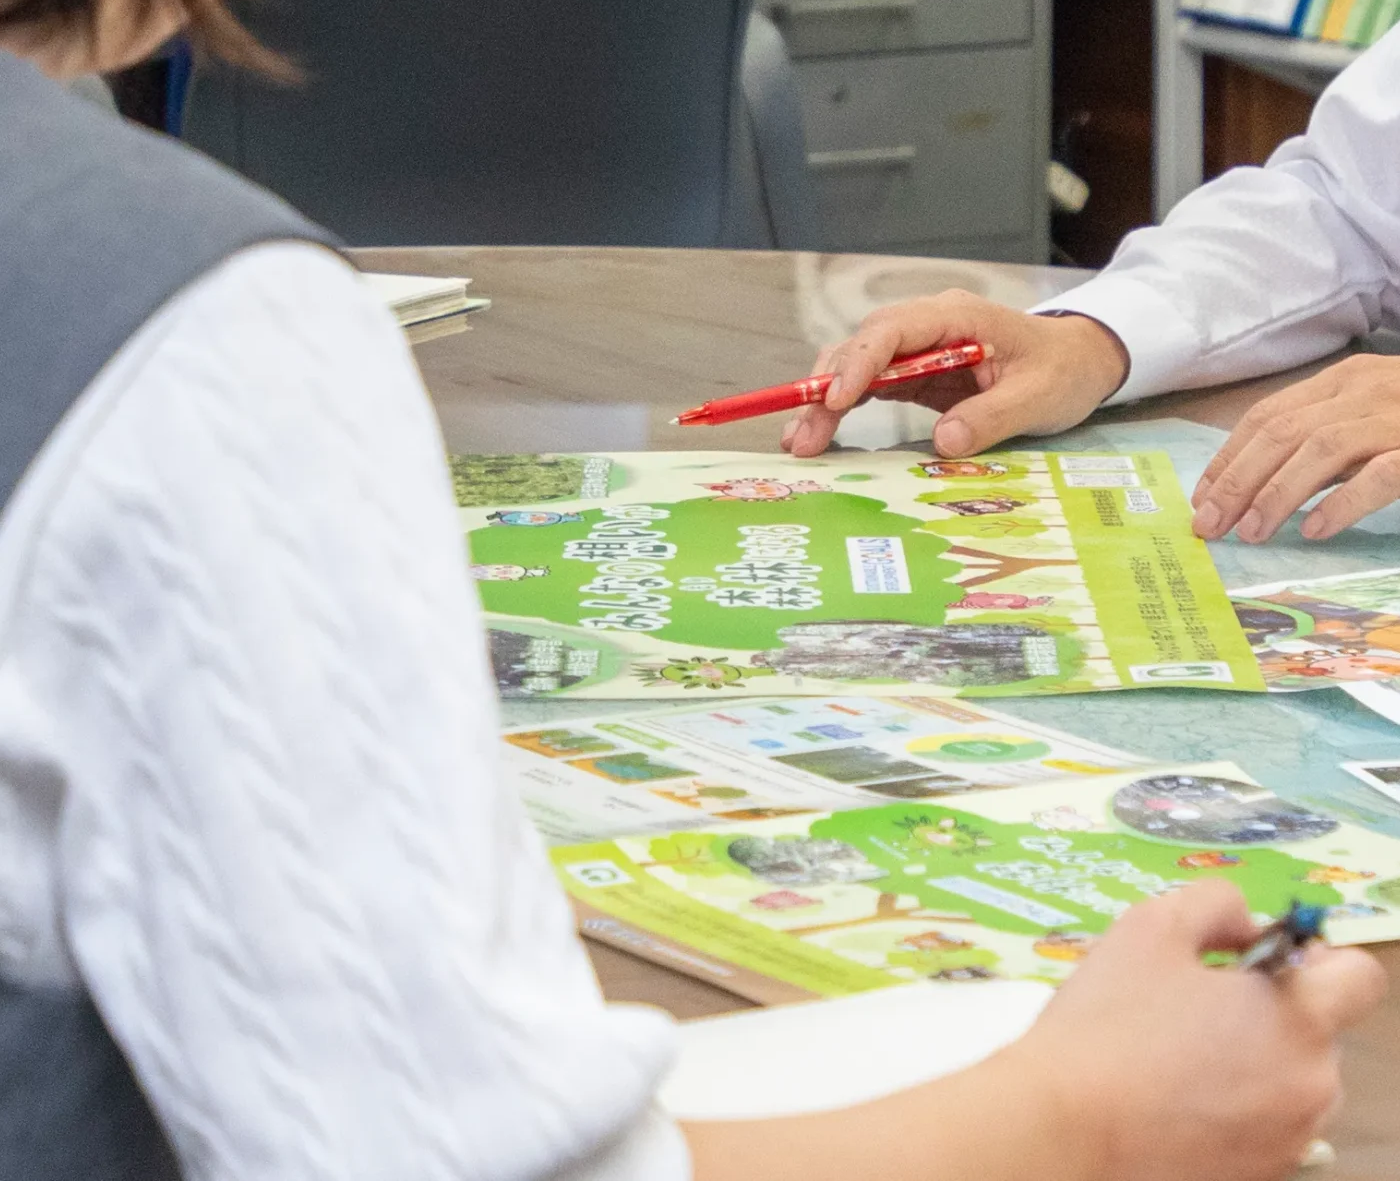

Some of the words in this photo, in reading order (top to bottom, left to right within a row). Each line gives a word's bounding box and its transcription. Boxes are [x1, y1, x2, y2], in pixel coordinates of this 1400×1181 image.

[566, 505, 674, 630] みんなの想いが
[708, 525, 822, 608] 森林になる
[857, 538, 895, 565] GOALS
